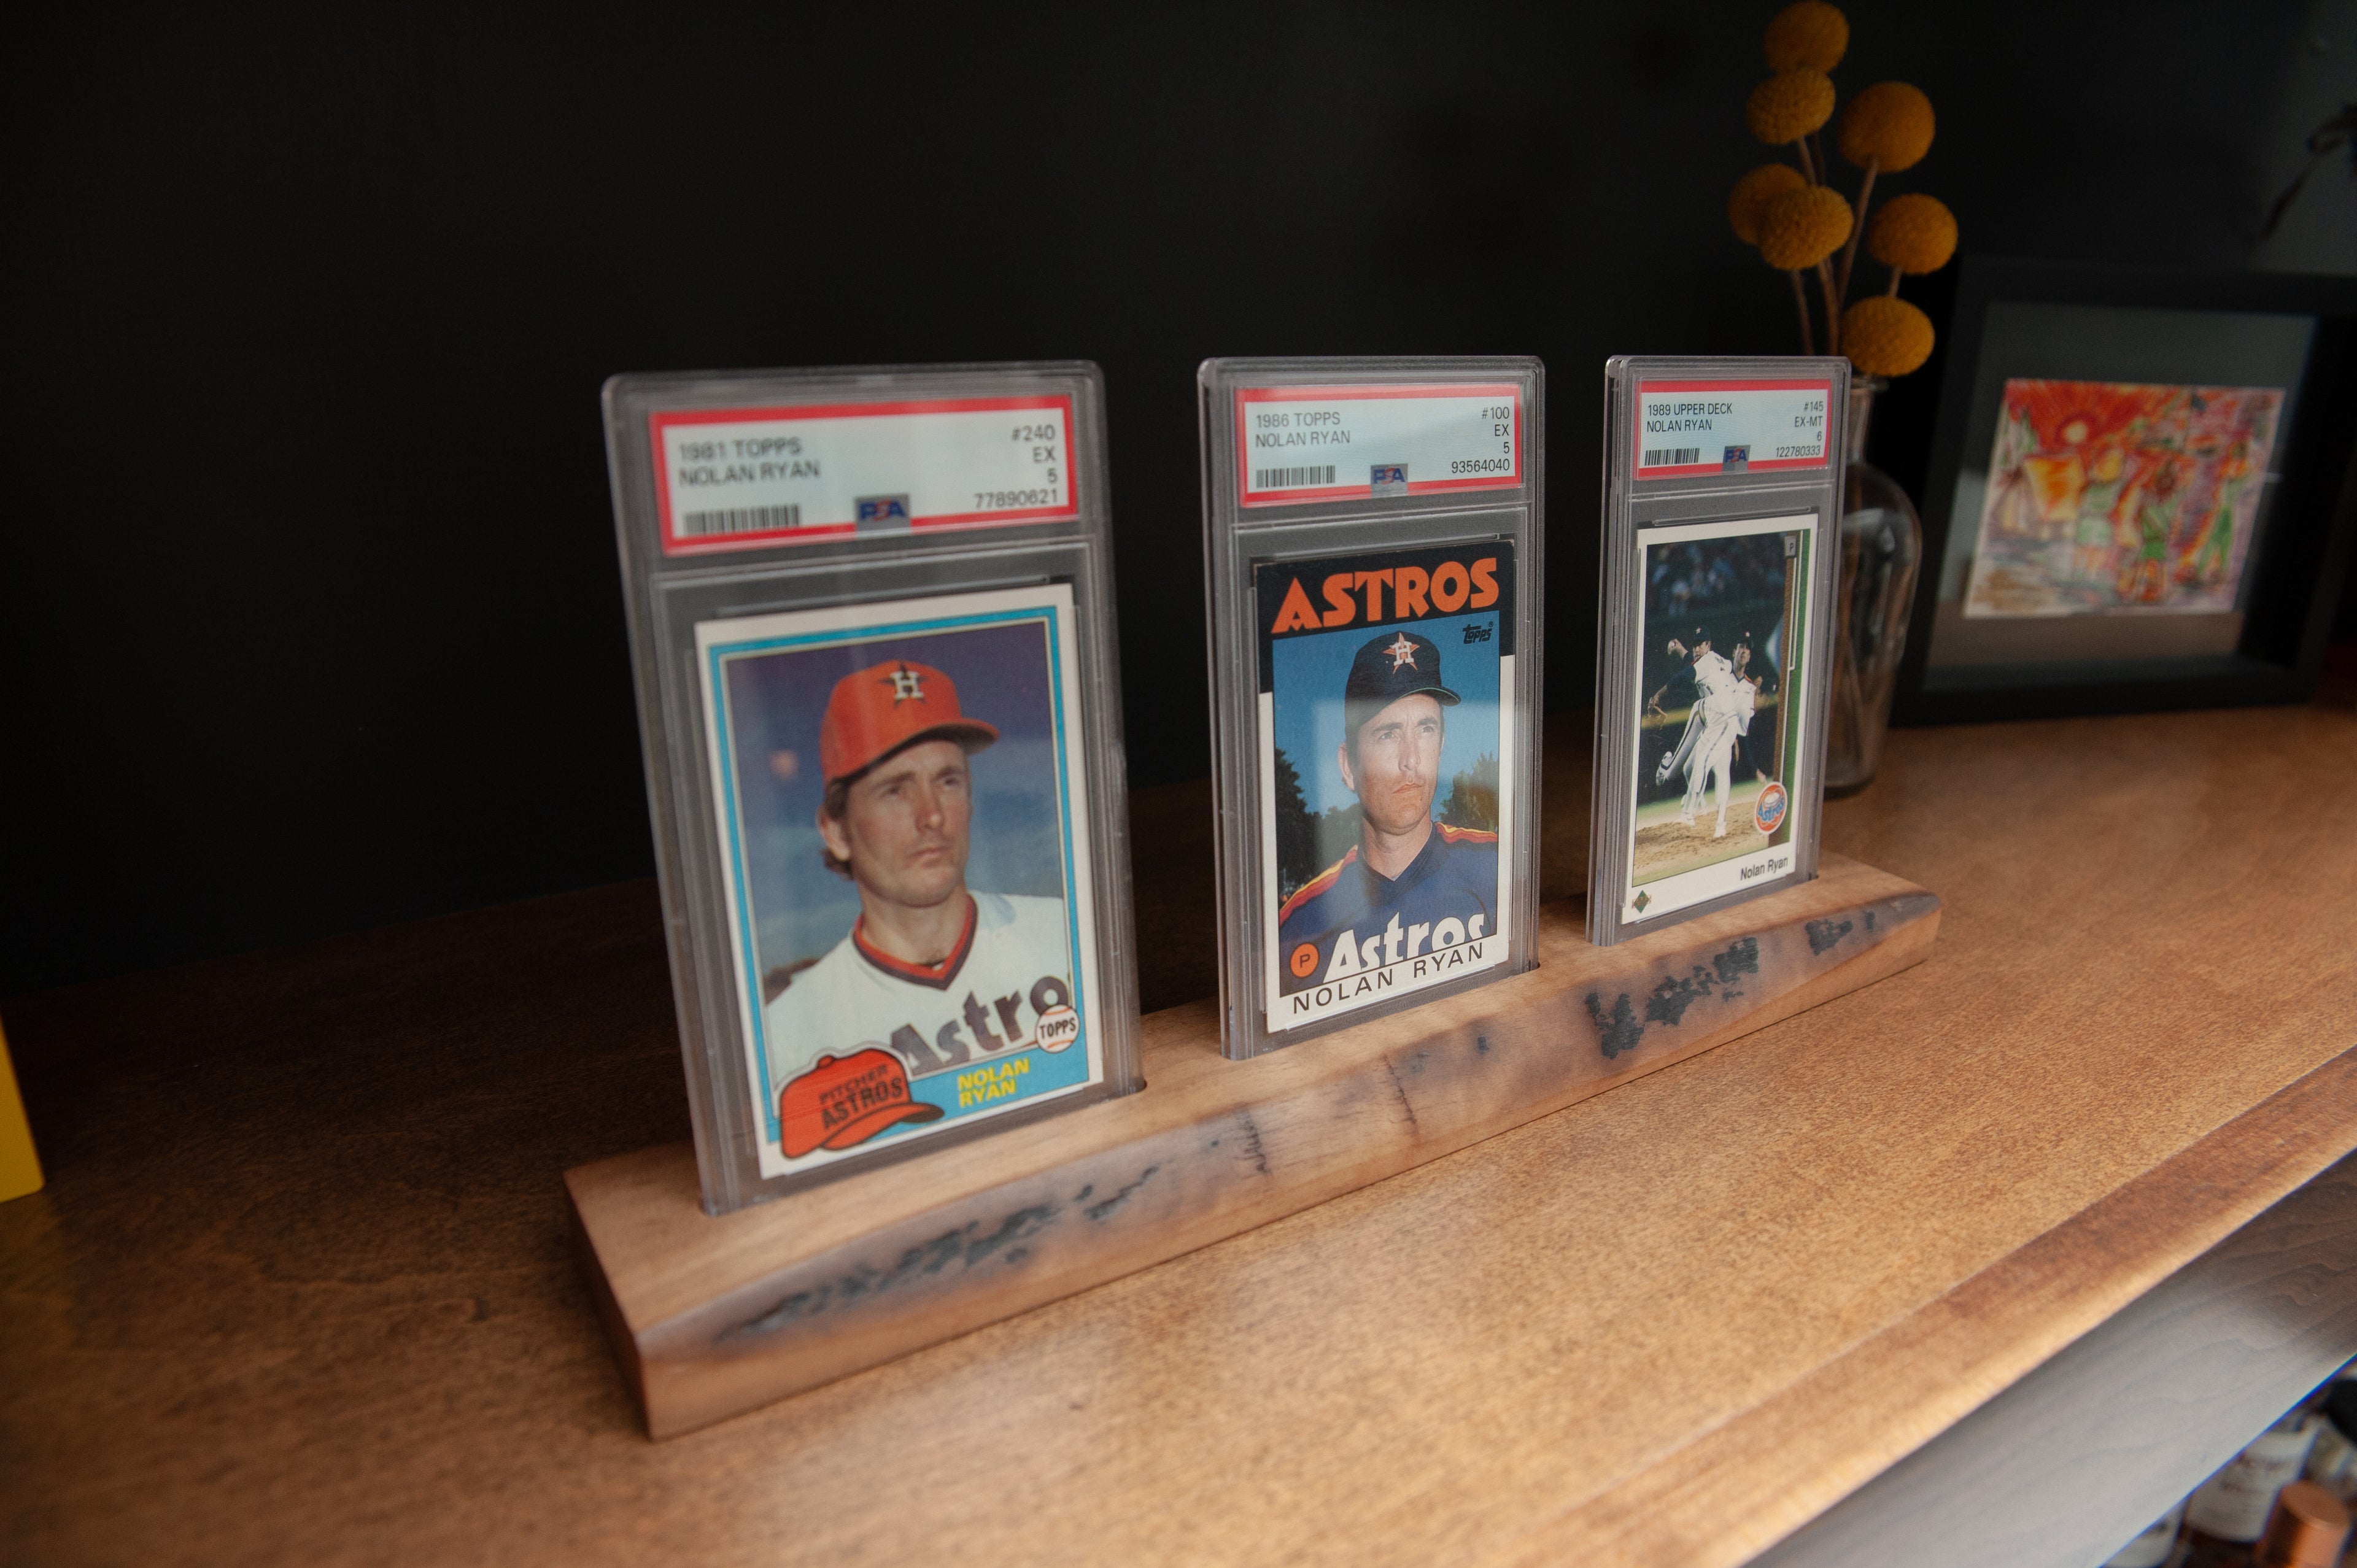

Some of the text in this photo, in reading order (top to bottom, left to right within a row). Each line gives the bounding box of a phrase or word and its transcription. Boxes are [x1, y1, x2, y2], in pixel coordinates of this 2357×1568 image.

[1482, 407, 1510, 420] #100
[1648, 403, 1733, 417] 1989 UPPER DECK
[1803, 401, 1824, 412] #145
[1256, 411, 1341, 428] 1986 TOPPS
[1647, 419, 1712, 433] NOLAN RYAN
[1795, 415, 1823, 428] EX-MT
[1012, 423, 1056, 441] #240
[1256, 430, 1350, 448] NOLAN RYAN
[1495, 424, 1510, 437] EX
[1817, 431, 1822, 442] 6
[679, 436, 802, 460] 1981 TOPPS
[1032, 446, 1056, 463] EX
[1503, 442, 1510, 454] 5
[1725, 447, 1747, 463] PSA
[1776, 445, 1821, 457] 122780333
[678, 460, 821, 487] NOLAN RYAN
[1451, 458, 1510, 474] 93564040
[1047, 468, 1058, 484] 5
[1372, 467, 1405, 484] PSA
[974, 487, 1058, 509] 77890621
[860, 500, 906, 522] PSA
[1271, 557, 1500, 634] ASTROS
[1390, 641, 1414, 665] H
[890, 671, 924, 698] H
[1740, 857, 1788, 881] Nolan Ryan
[1323, 911, 1484, 984] Astros
[1299, 954, 1310, 968] P
[1293, 943, 1483, 1014] NOLAN RYAN
[1039, 1016, 1077, 1041] TOPPS
[820, 1064, 888, 1104] PITCHER
[957, 1057, 1030, 1093] NOLAN
[959, 1078, 1016, 1108] RYAN
[821, 1076, 903, 1130] ASTROS
